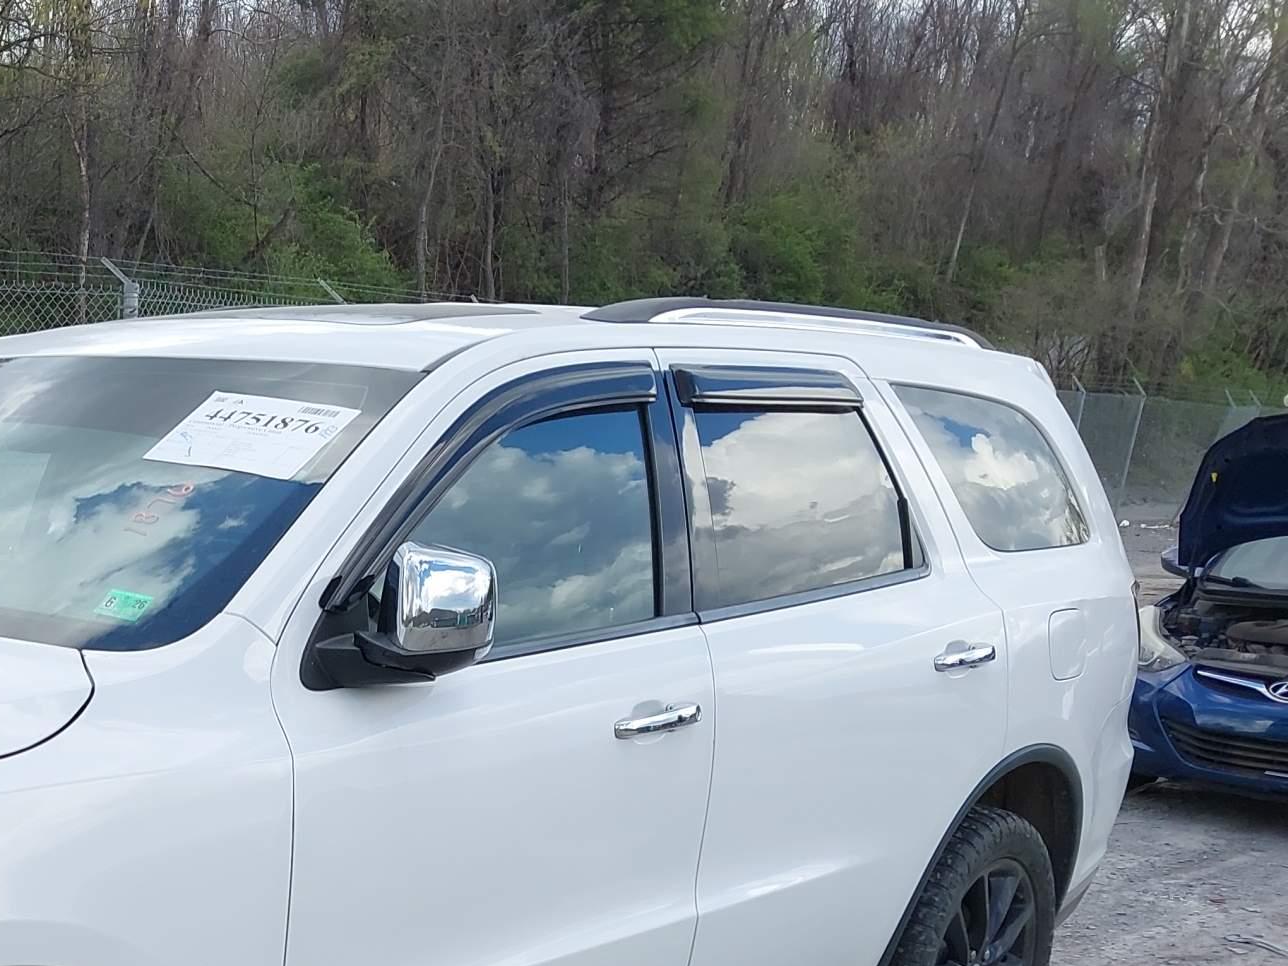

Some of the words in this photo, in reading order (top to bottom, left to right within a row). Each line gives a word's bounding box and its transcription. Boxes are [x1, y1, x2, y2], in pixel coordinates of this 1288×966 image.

[205, 409, 324, 434] 44751876
[105, 597, 116, 607] 6
[132, 600, 147, 609] 26
